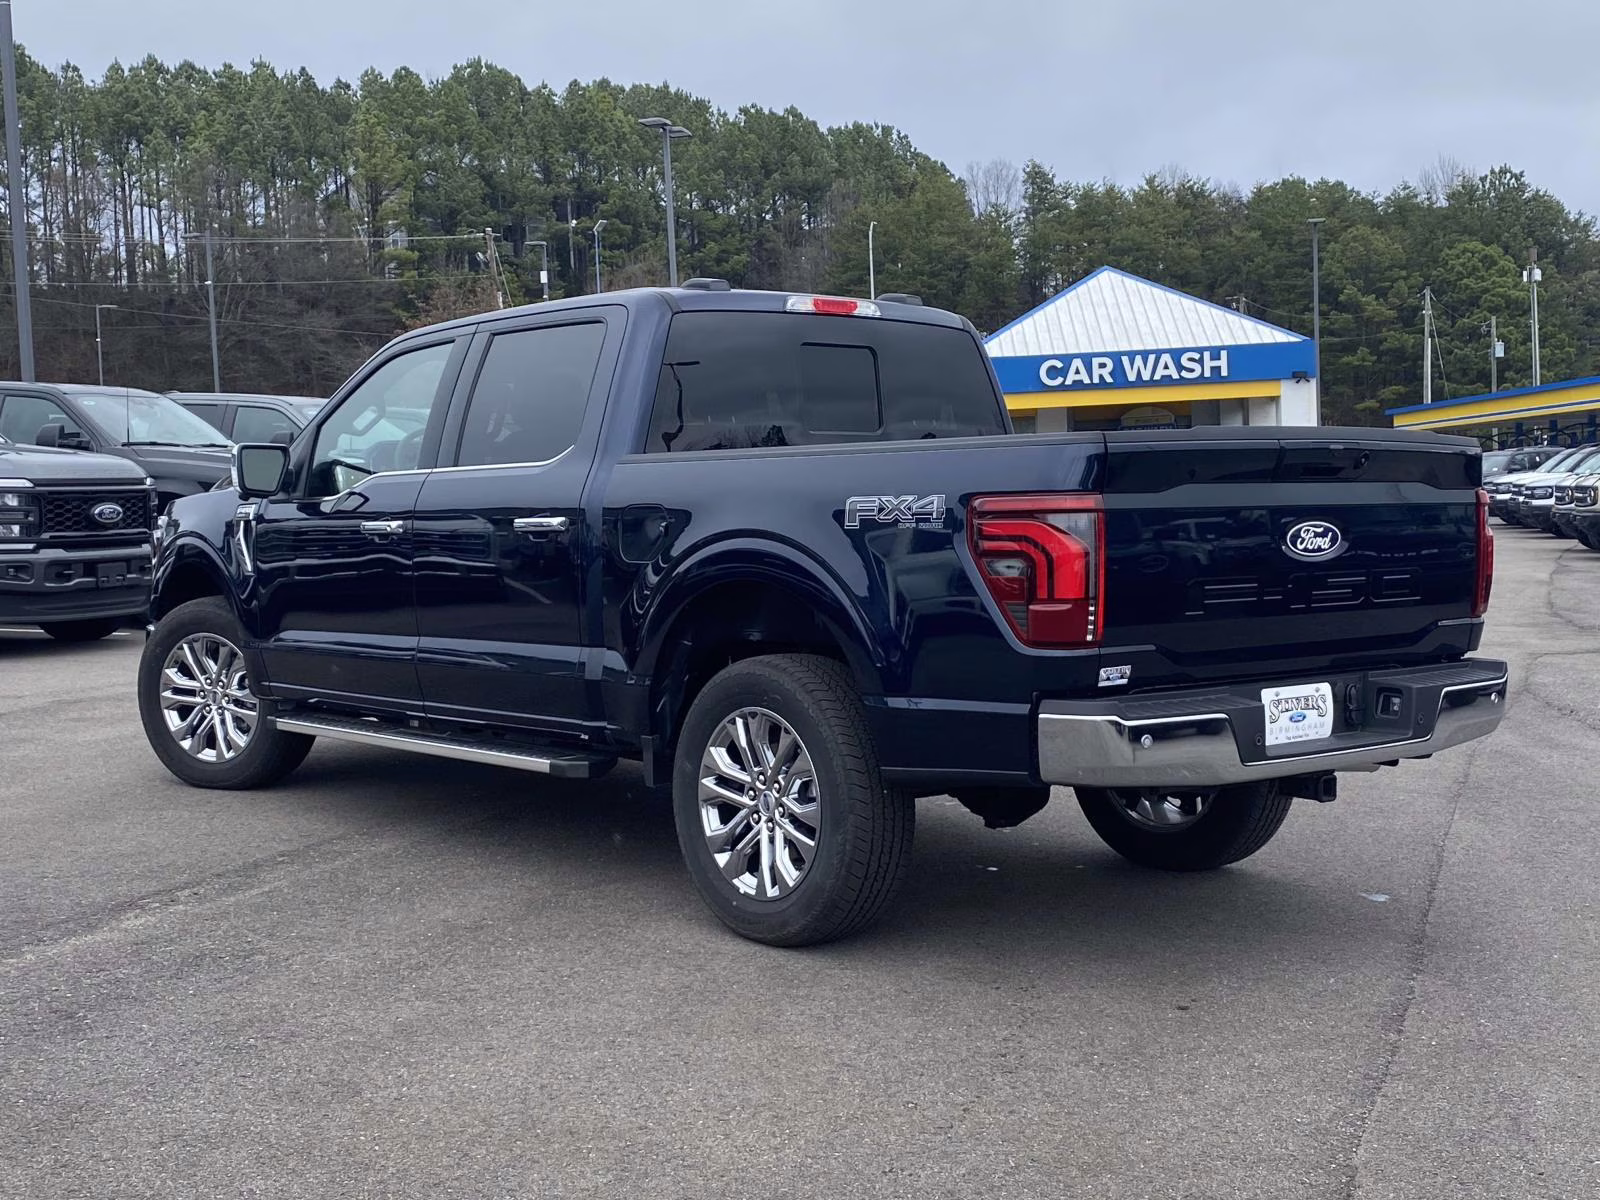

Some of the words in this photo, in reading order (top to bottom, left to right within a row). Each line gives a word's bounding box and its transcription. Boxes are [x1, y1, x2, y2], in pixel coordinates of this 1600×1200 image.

[1039, 356, 1114, 387] CAR
[1121, 350, 1229, 382] WASH
[844, 494, 946, 529] FX4
[1297, 525, 1333, 551] Ford
[1269, 694, 1328, 724] STIVERS
[1269, 721, 1325, 736] BIRMINGHAM
